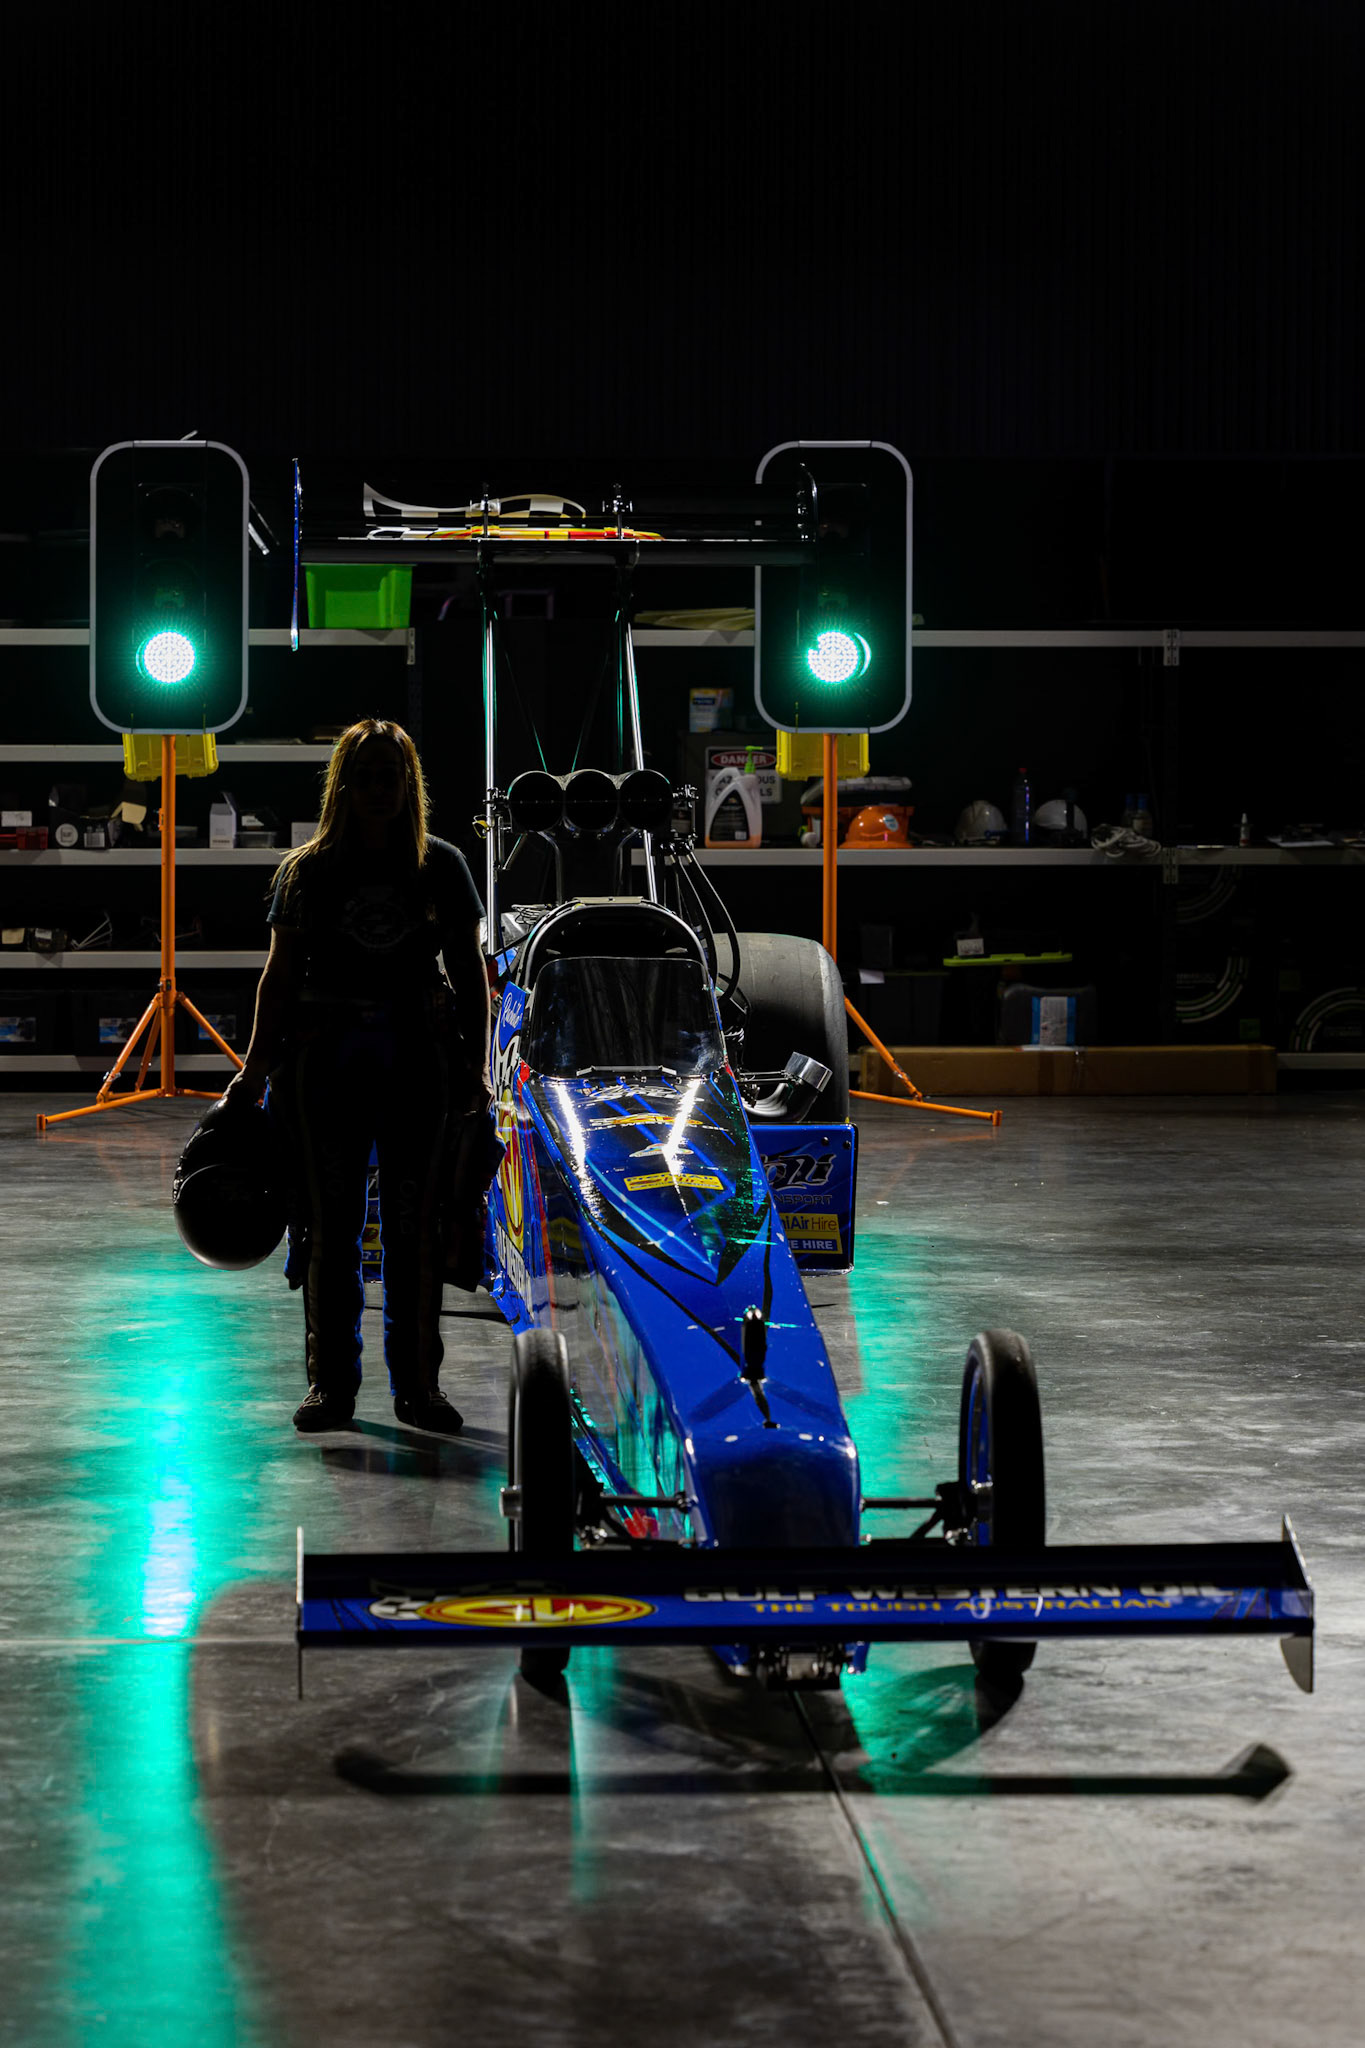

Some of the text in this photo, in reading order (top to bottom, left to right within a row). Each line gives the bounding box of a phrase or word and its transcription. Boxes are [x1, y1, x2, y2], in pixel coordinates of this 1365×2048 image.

[720, 755, 767, 764] DANER
[802, 1240, 834, 1250] HIRE
[683, 1580, 1235, 1602] GULF WESTERN OIL
[751, 1598, 1173, 1613] THE TOUGH AUSTRALIAN
